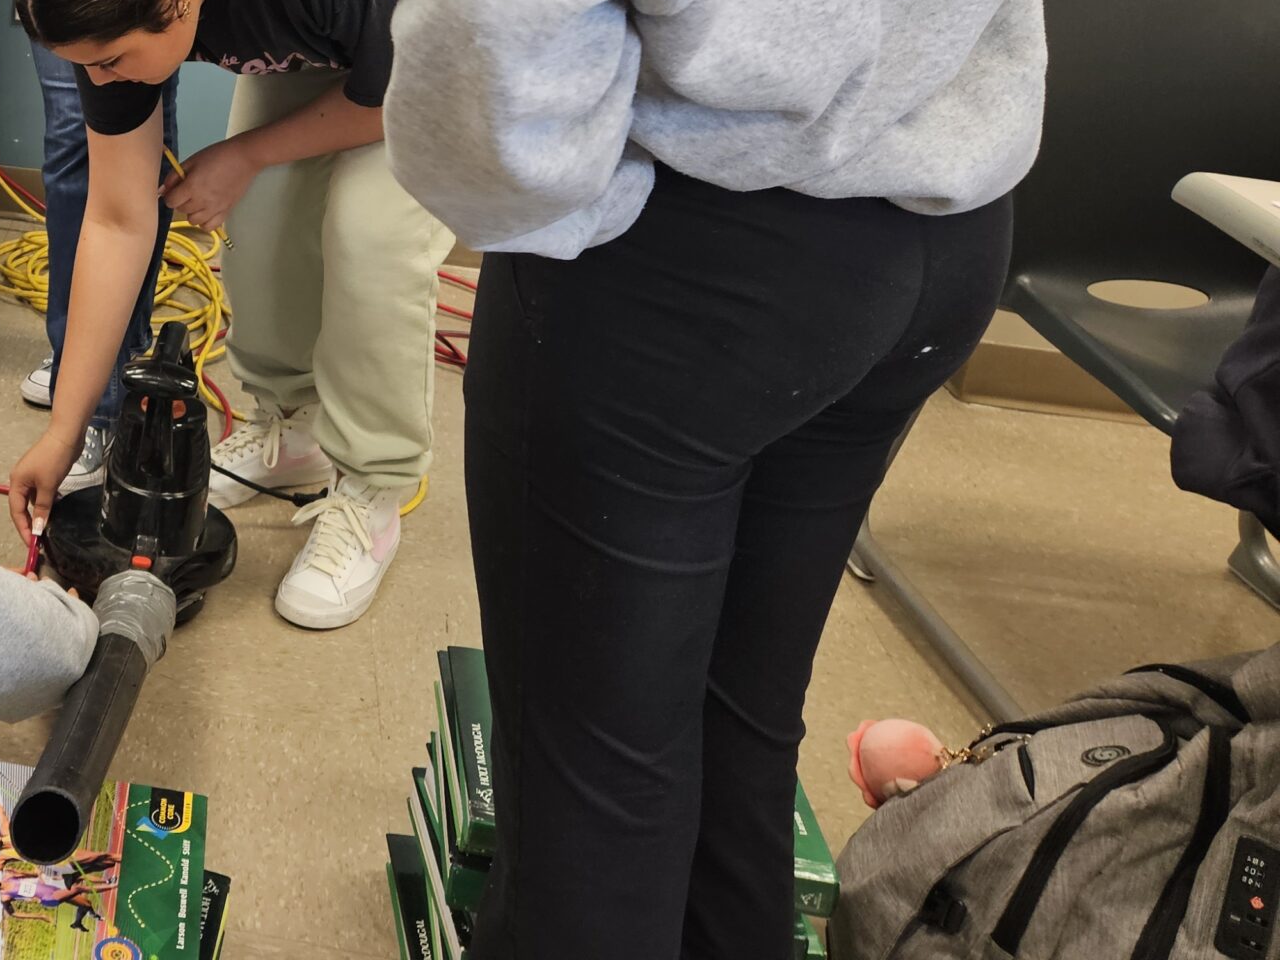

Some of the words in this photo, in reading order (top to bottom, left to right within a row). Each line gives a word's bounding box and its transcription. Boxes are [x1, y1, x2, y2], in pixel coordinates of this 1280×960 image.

[478, 765, 490, 786] HOLT
[158, 798, 168, 824] COMMON
[180, 858, 190, 886] Kanold
[178, 888, 188, 919] Boswell
[176, 922, 186, 950] Larson
